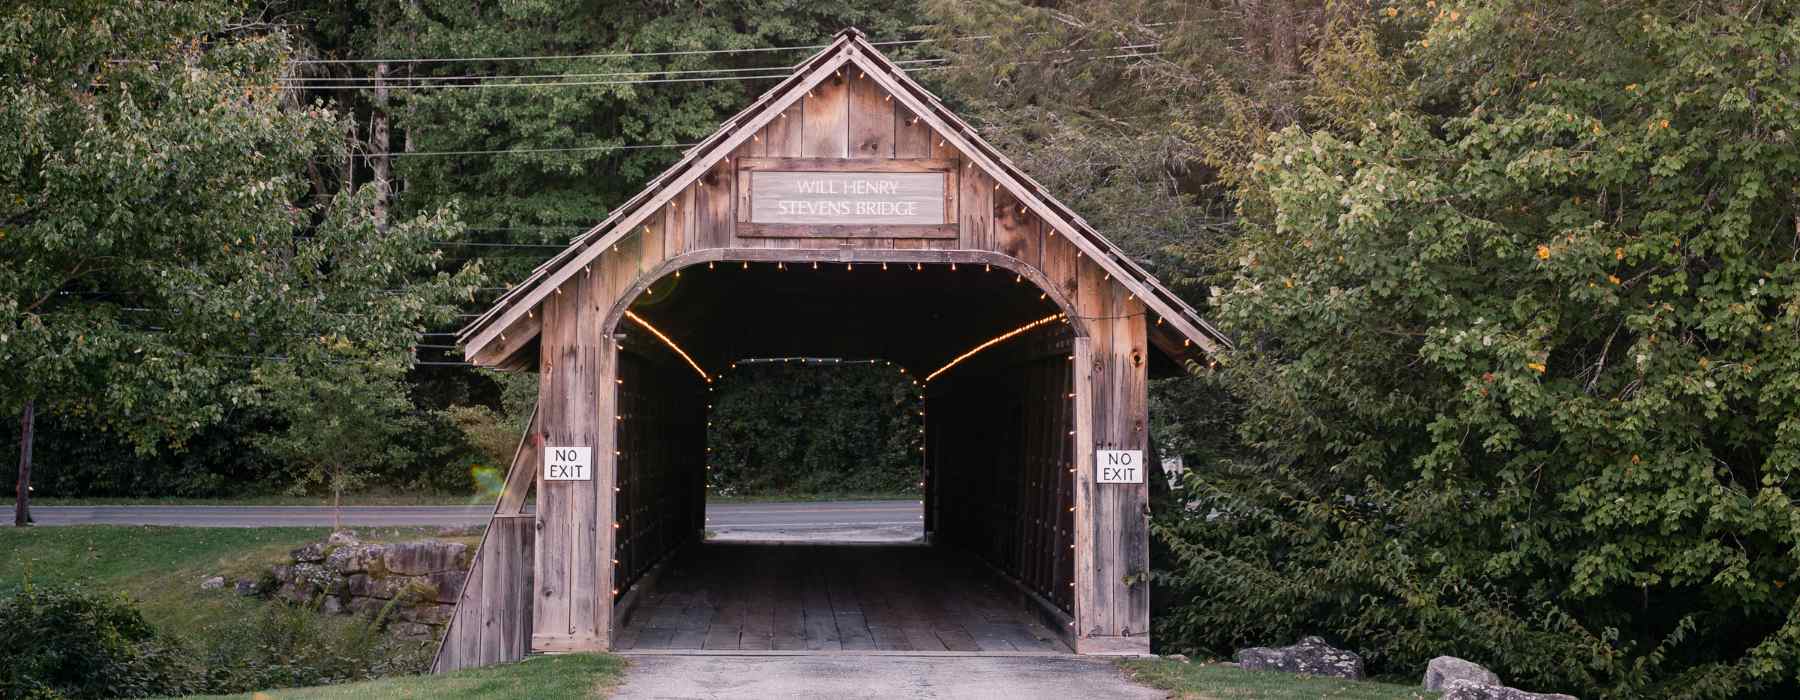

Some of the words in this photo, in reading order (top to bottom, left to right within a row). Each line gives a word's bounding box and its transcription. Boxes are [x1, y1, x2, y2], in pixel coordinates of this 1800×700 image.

[797, 180, 837, 194] WILL
[843, 180, 899, 194] HENRY
[778, 201, 849, 216] STEVENS
[856, 201, 918, 216] BRIDGE
[555, 449, 577, 461] NO
[1108, 452, 1131, 465] NO
[550, 464, 583, 478] EXIT
[1103, 468, 1135, 480] EXIT
